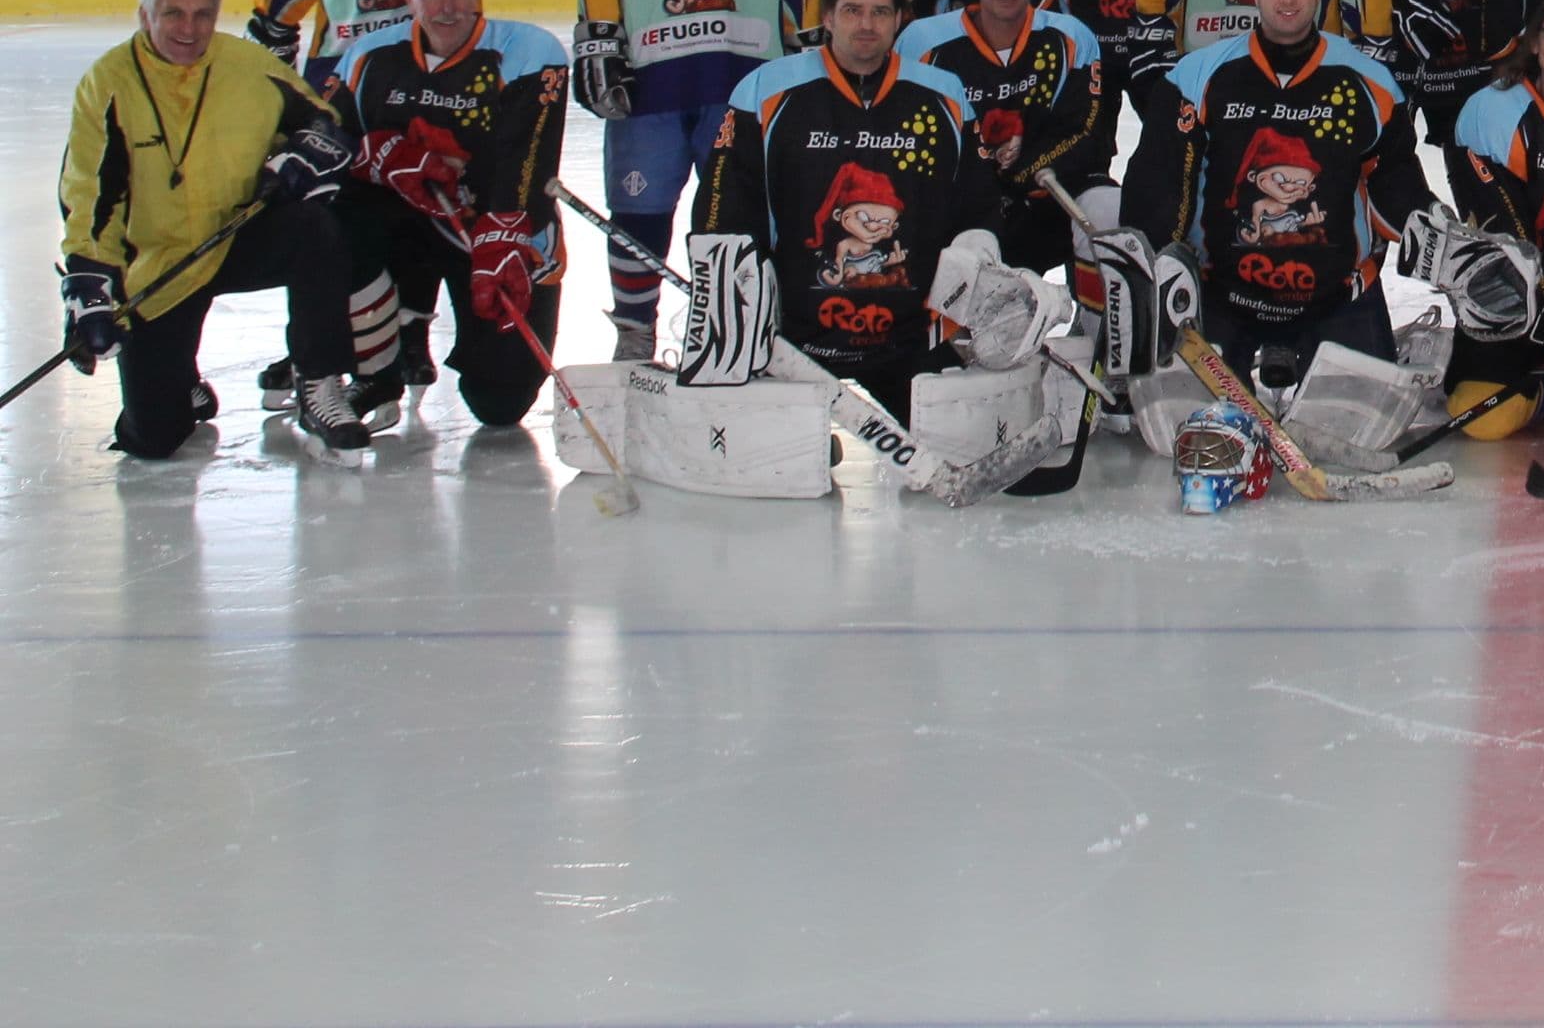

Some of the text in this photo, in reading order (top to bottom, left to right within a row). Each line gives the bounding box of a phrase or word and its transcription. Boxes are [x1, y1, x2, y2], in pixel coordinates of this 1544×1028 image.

[1195, 14, 1260, 33] REFUGI
[420, 89, 478, 110] Buaba
[1223, 102, 1334, 121] Eis Buaba
[806, 131, 917, 150] Eis Buaba
[1420, 228, 1440, 282] VAUGHN
[687, 260, 711, 354] VAUGHN
[1109, 280, 1122, 370] VAUGHN
[628, 371, 669, 397] Reebok
